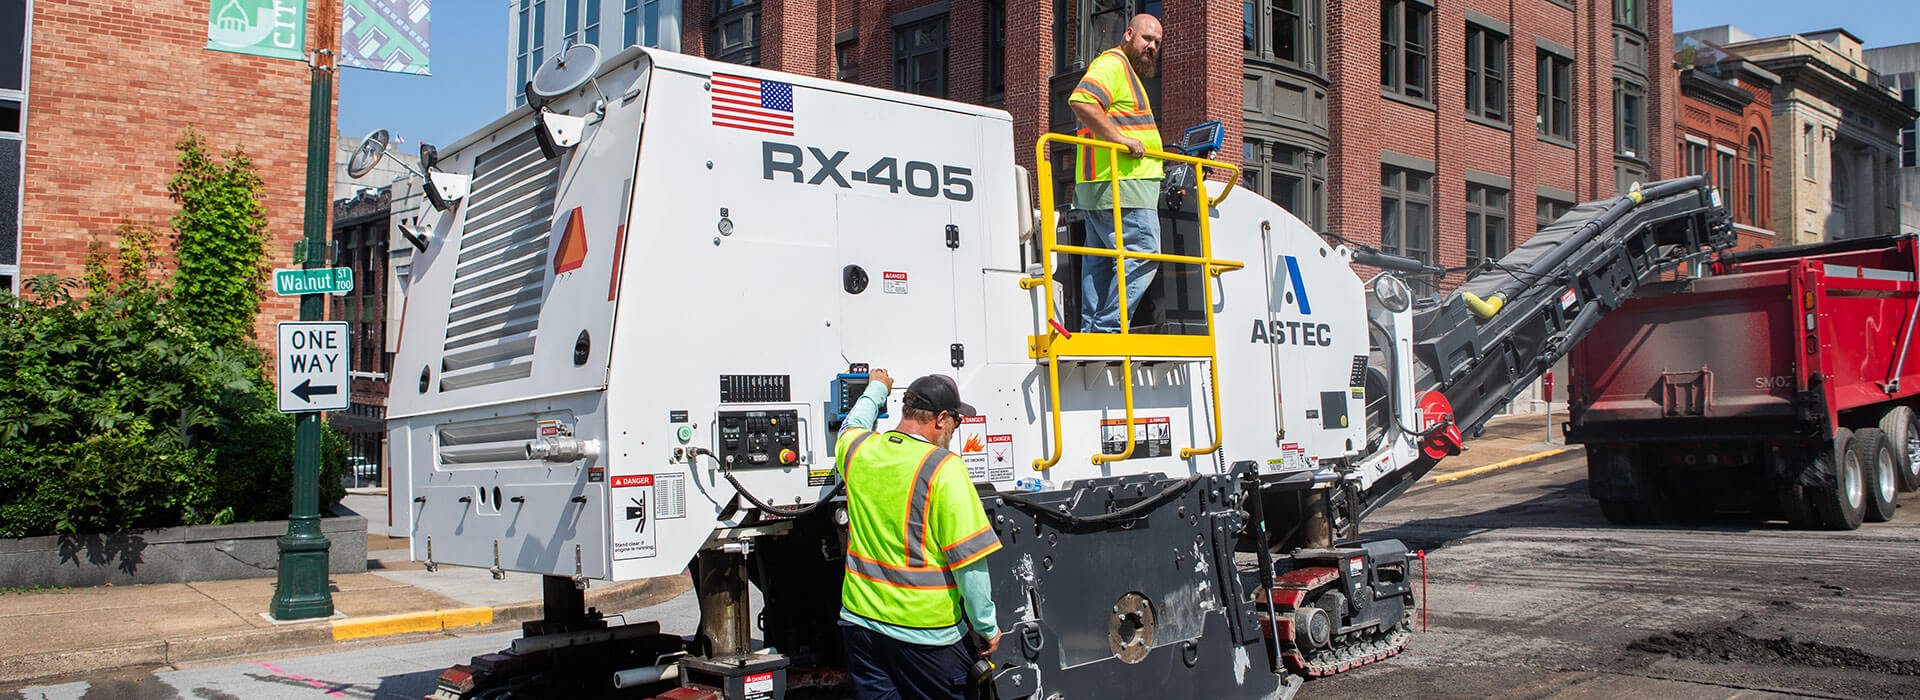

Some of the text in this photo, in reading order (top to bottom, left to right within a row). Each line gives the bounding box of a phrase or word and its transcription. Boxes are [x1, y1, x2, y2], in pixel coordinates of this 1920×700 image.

[762, 140, 974, 202] RX-405
[280, 273, 331, 291] Walnut
[338, 269, 347, 279] ST
[336, 280, 351, 290] 700
[291, 330, 338, 350] ONE
[1250, 319, 1332, 347] ASTEC
[290, 354, 339, 373] WAY
[623, 477, 650, 485] DANGER
